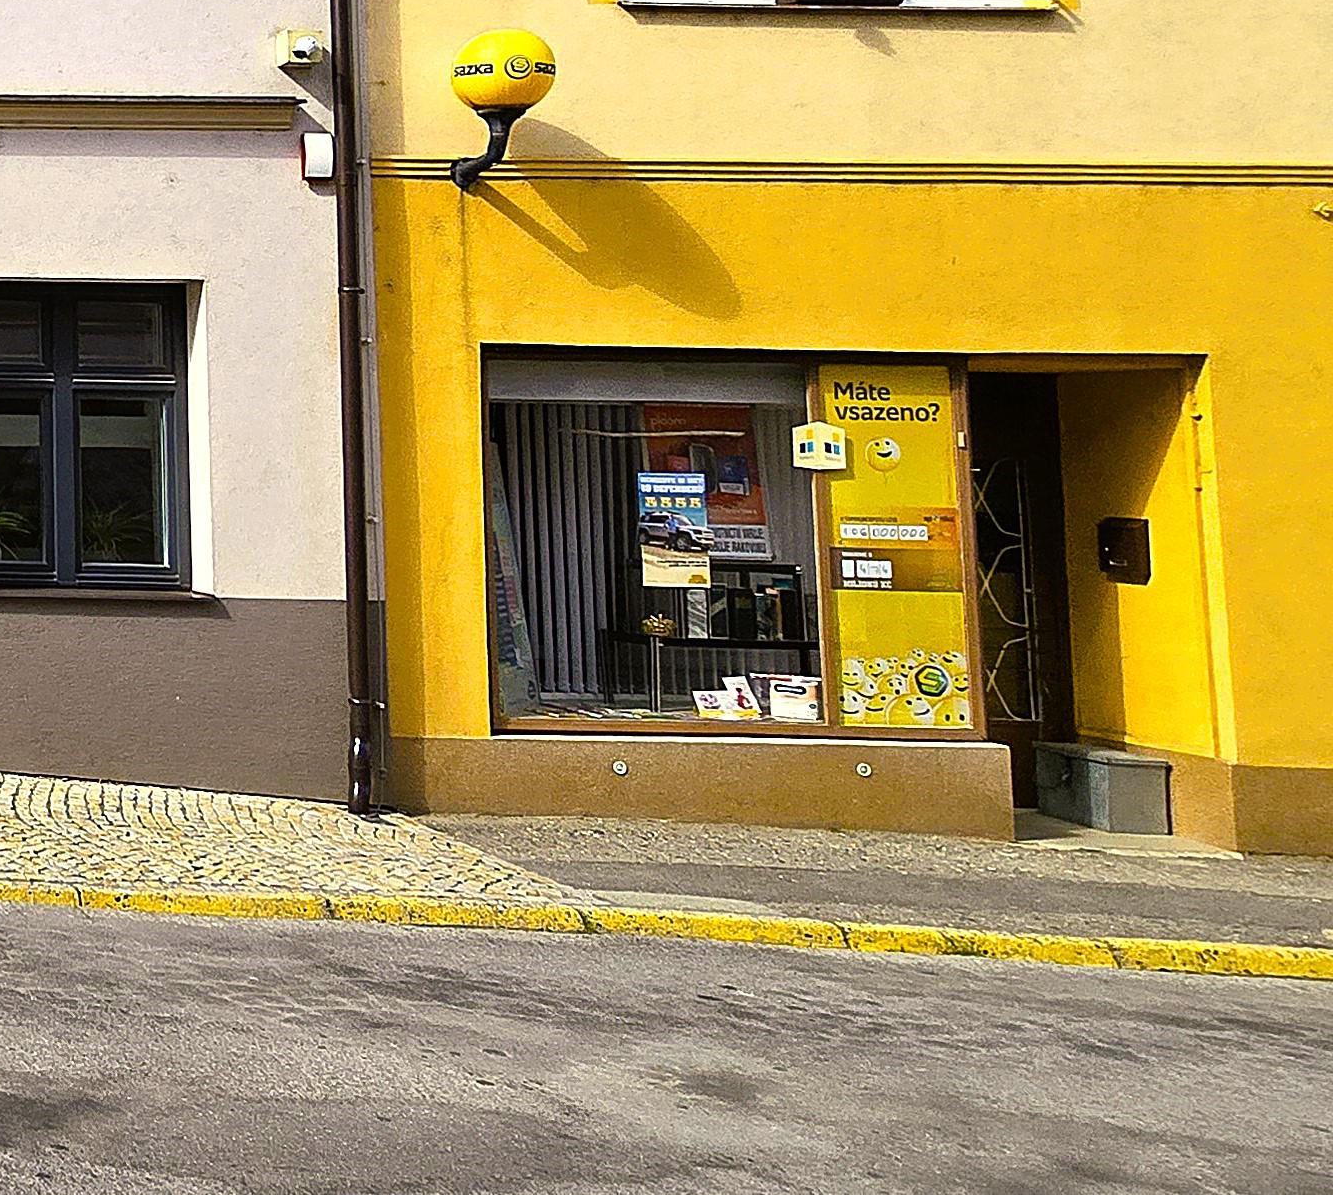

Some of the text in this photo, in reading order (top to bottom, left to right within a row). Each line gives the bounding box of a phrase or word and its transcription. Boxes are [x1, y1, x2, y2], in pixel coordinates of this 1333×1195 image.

[454, 63, 493, 77] sazka
[833, 380, 891, 402] Máte
[834, 402, 941, 423] vsazeno?
